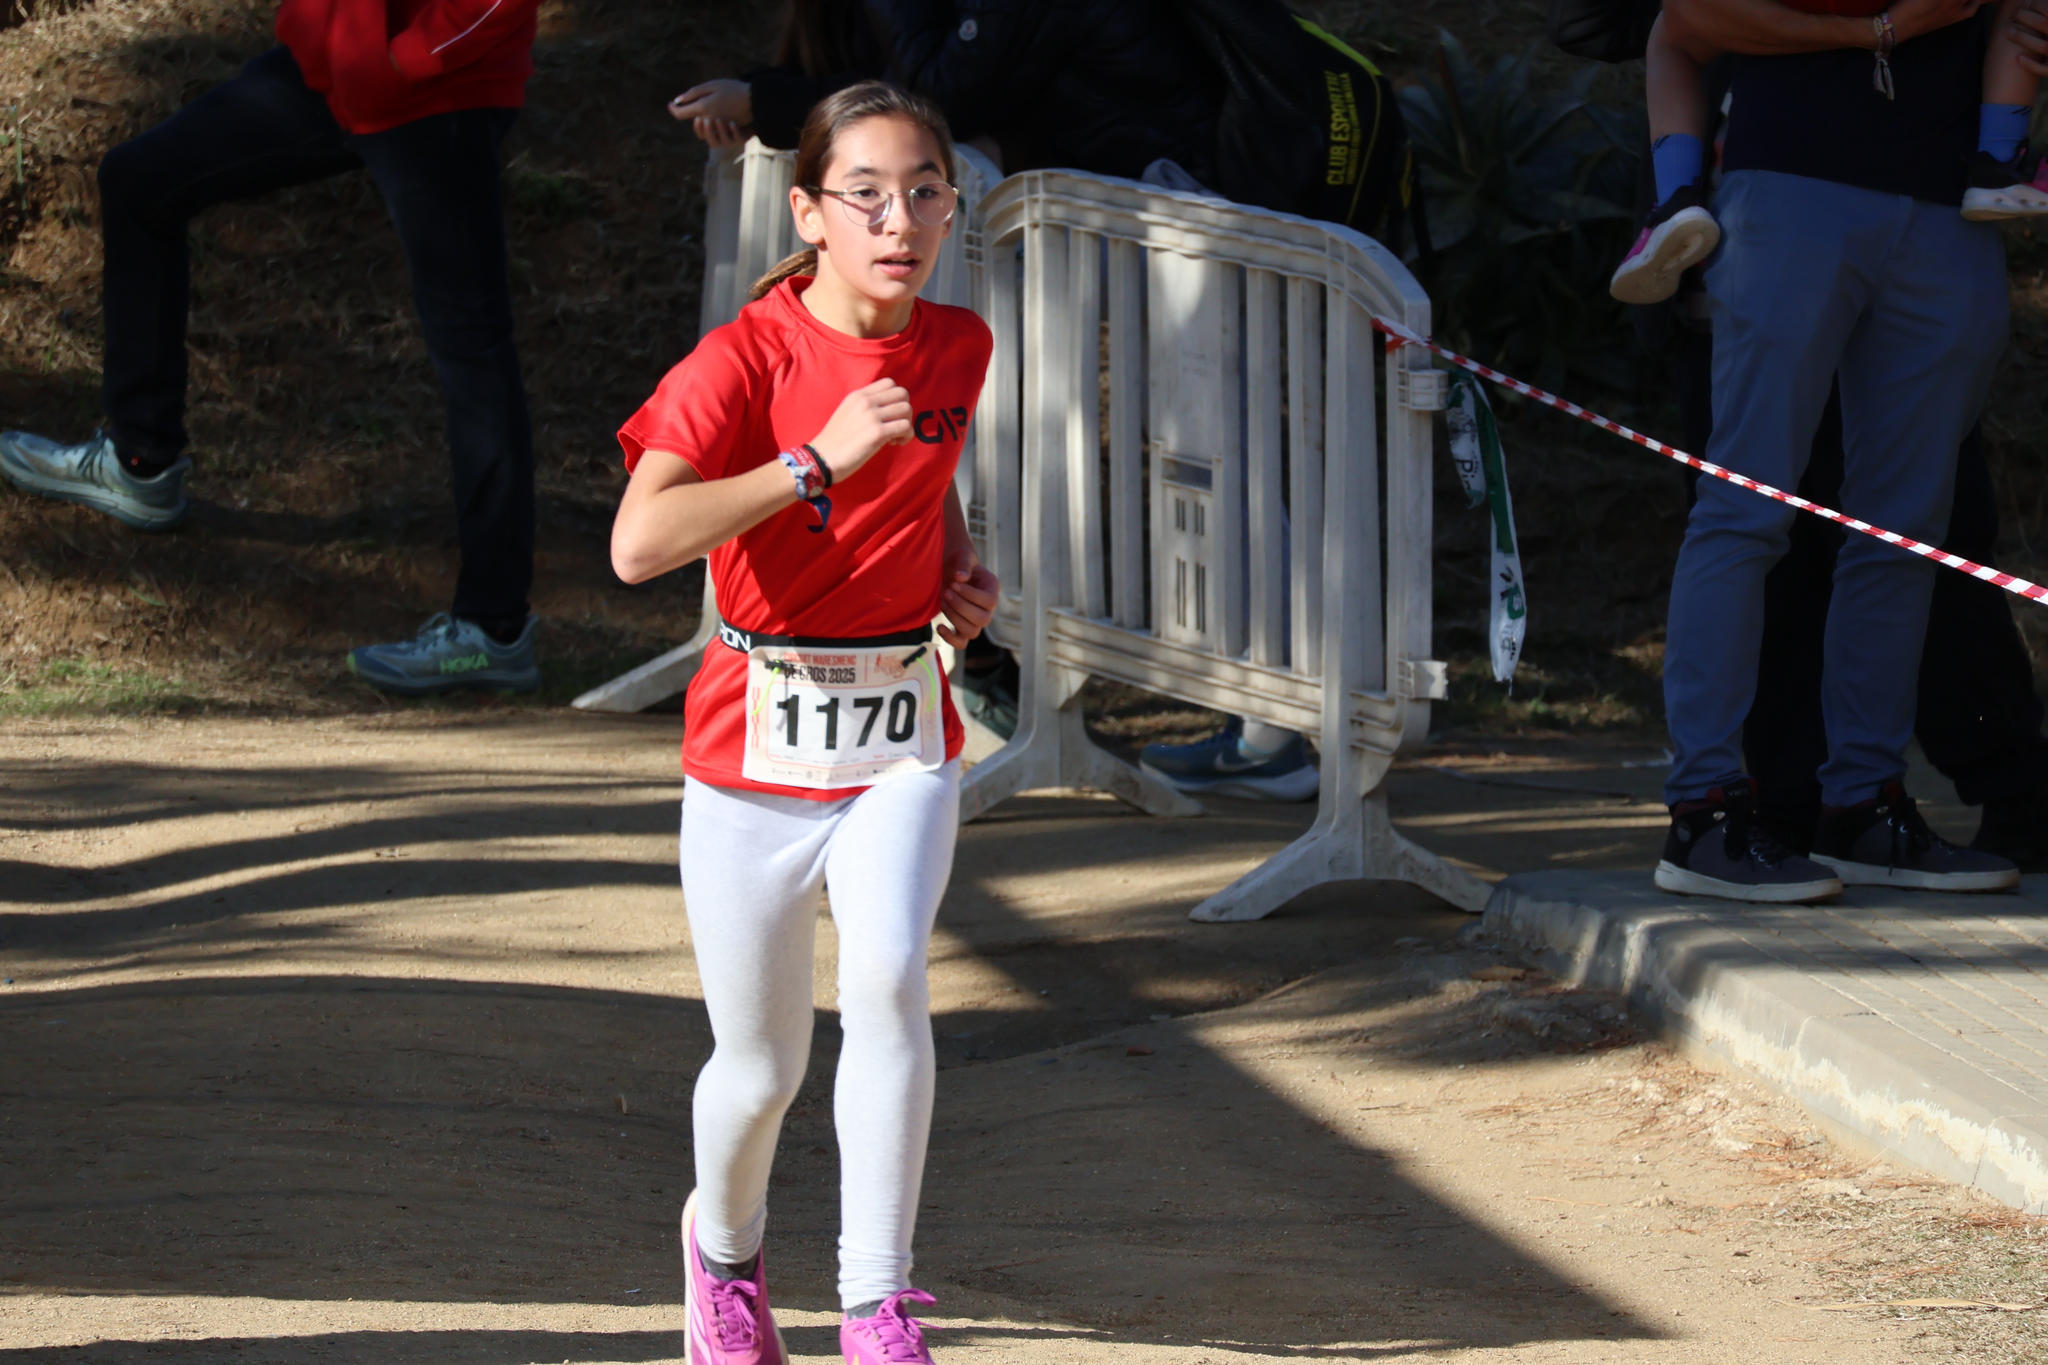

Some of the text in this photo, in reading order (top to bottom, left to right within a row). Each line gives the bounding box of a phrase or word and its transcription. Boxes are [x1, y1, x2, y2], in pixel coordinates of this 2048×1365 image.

[1326, 146, 1349, 185] CLUB
[440, 653, 489, 674] HOKA
[829, 667, 856, 684] 2025
[776, 690, 917, 750] 1170
